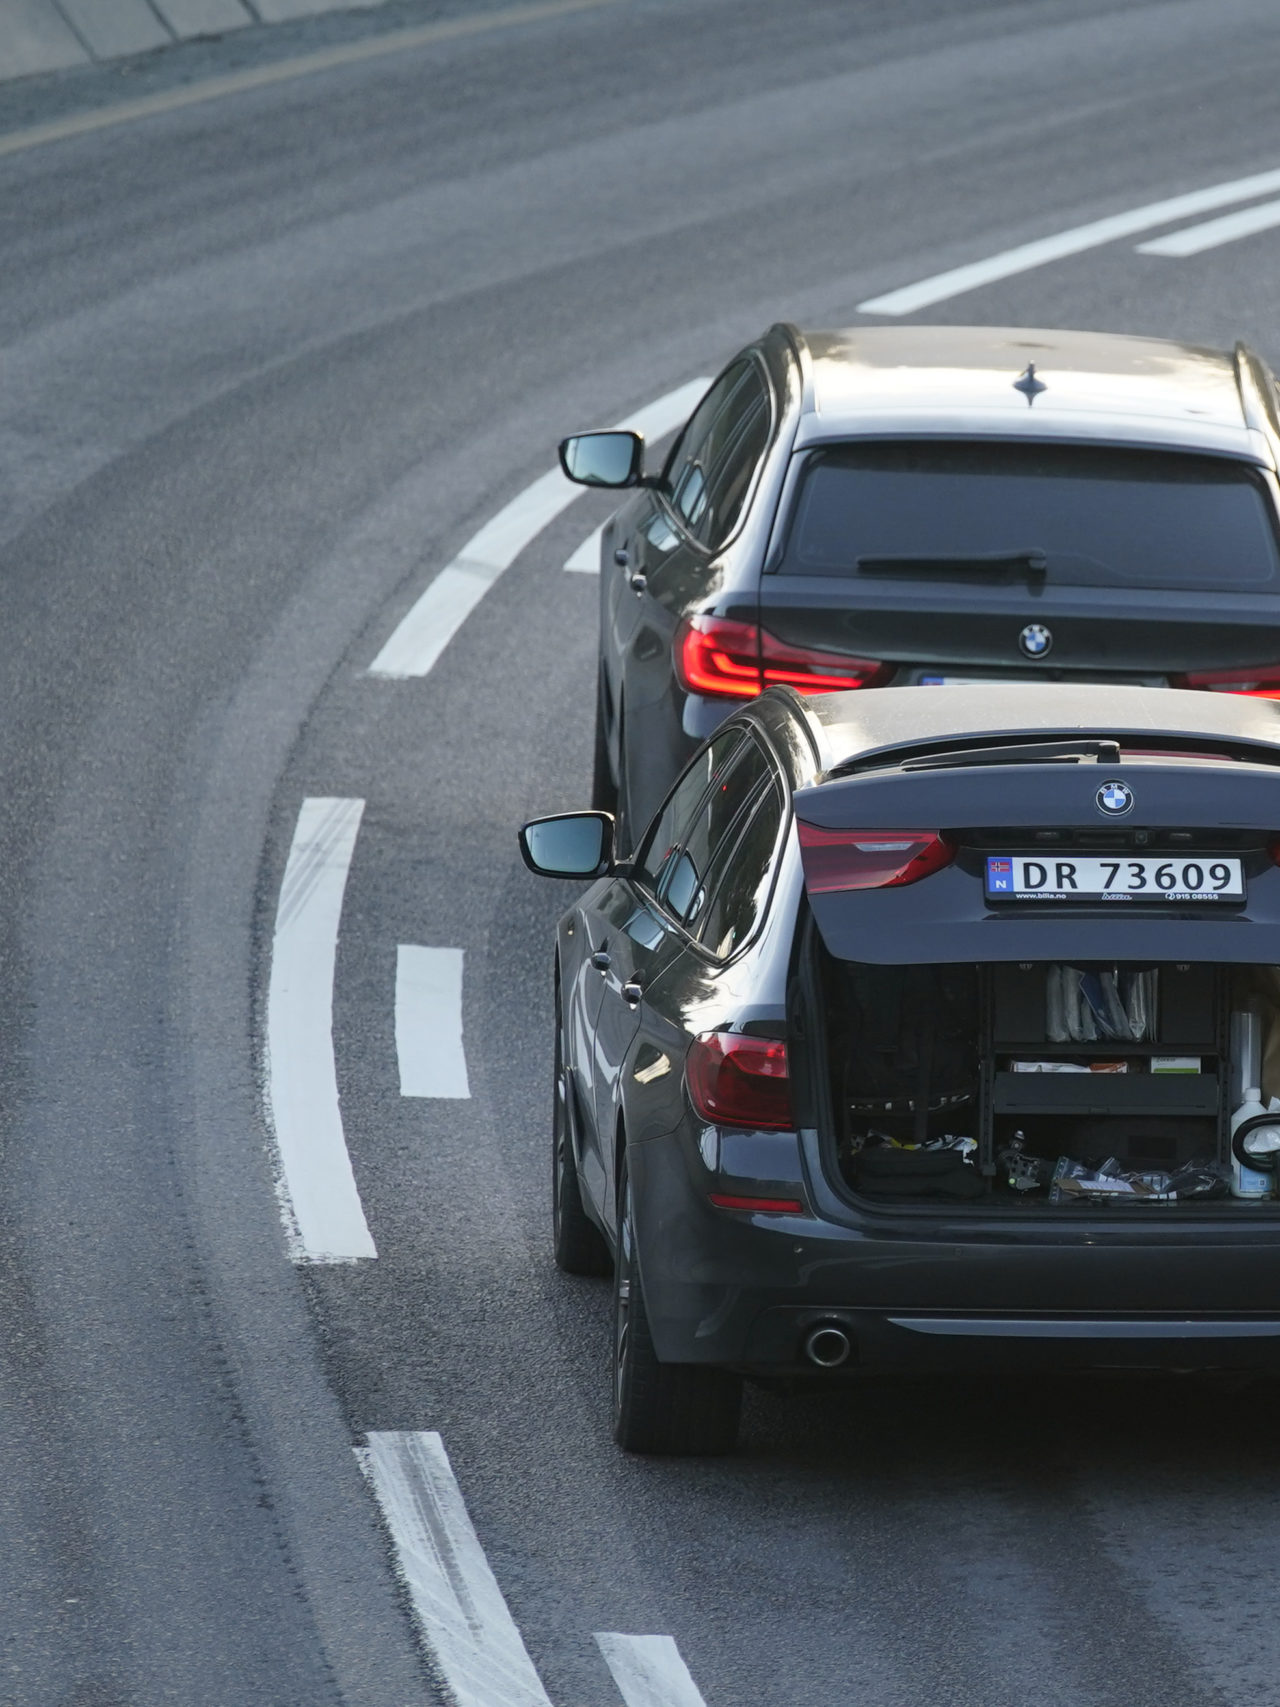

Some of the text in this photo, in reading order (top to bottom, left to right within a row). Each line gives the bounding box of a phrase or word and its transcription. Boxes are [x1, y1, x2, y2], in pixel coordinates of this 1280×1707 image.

[995, 880, 1007, 889] N
[1022, 862, 1232, 891] DR 73609
